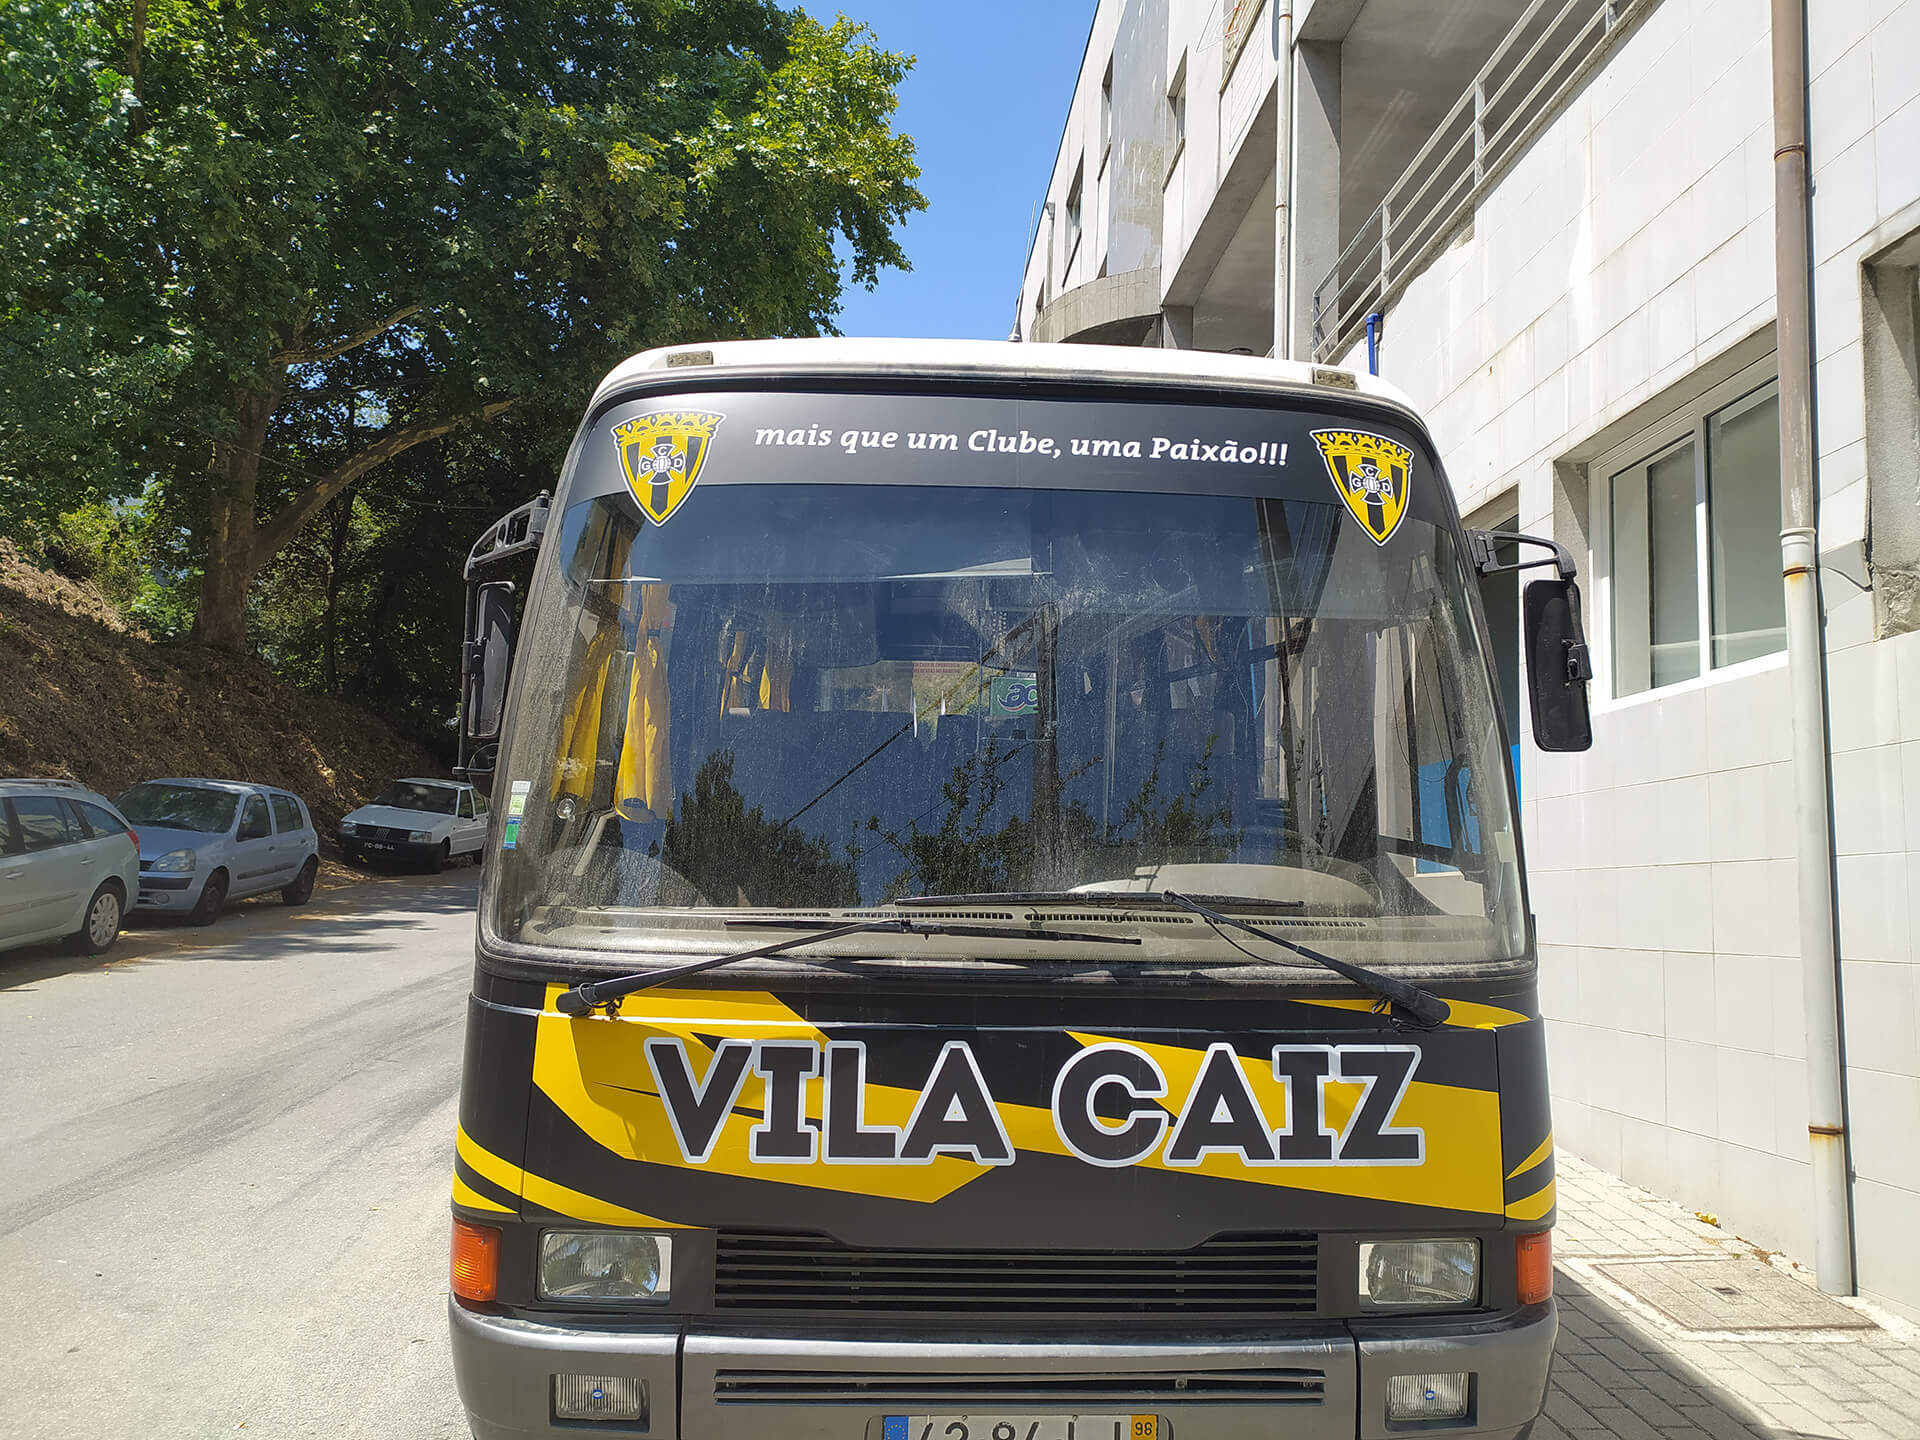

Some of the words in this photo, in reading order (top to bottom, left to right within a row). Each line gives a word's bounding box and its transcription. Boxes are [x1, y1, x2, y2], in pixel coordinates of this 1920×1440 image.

[754, 423, 833, 446] mais
[840, 430, 899, 454] que
[907, 432, 959, 451] um
[968, 429, 1061, 459] Clube,
[1070, 439, 1142, 458] uma
[1149, 437, 1288, 466] Paixão!!!
[644, 1039, 1016, 1165] VILA
[1052, 1042, 1426, 1168] CAIZ
[1135, 1422, 1153, 1436] 98
